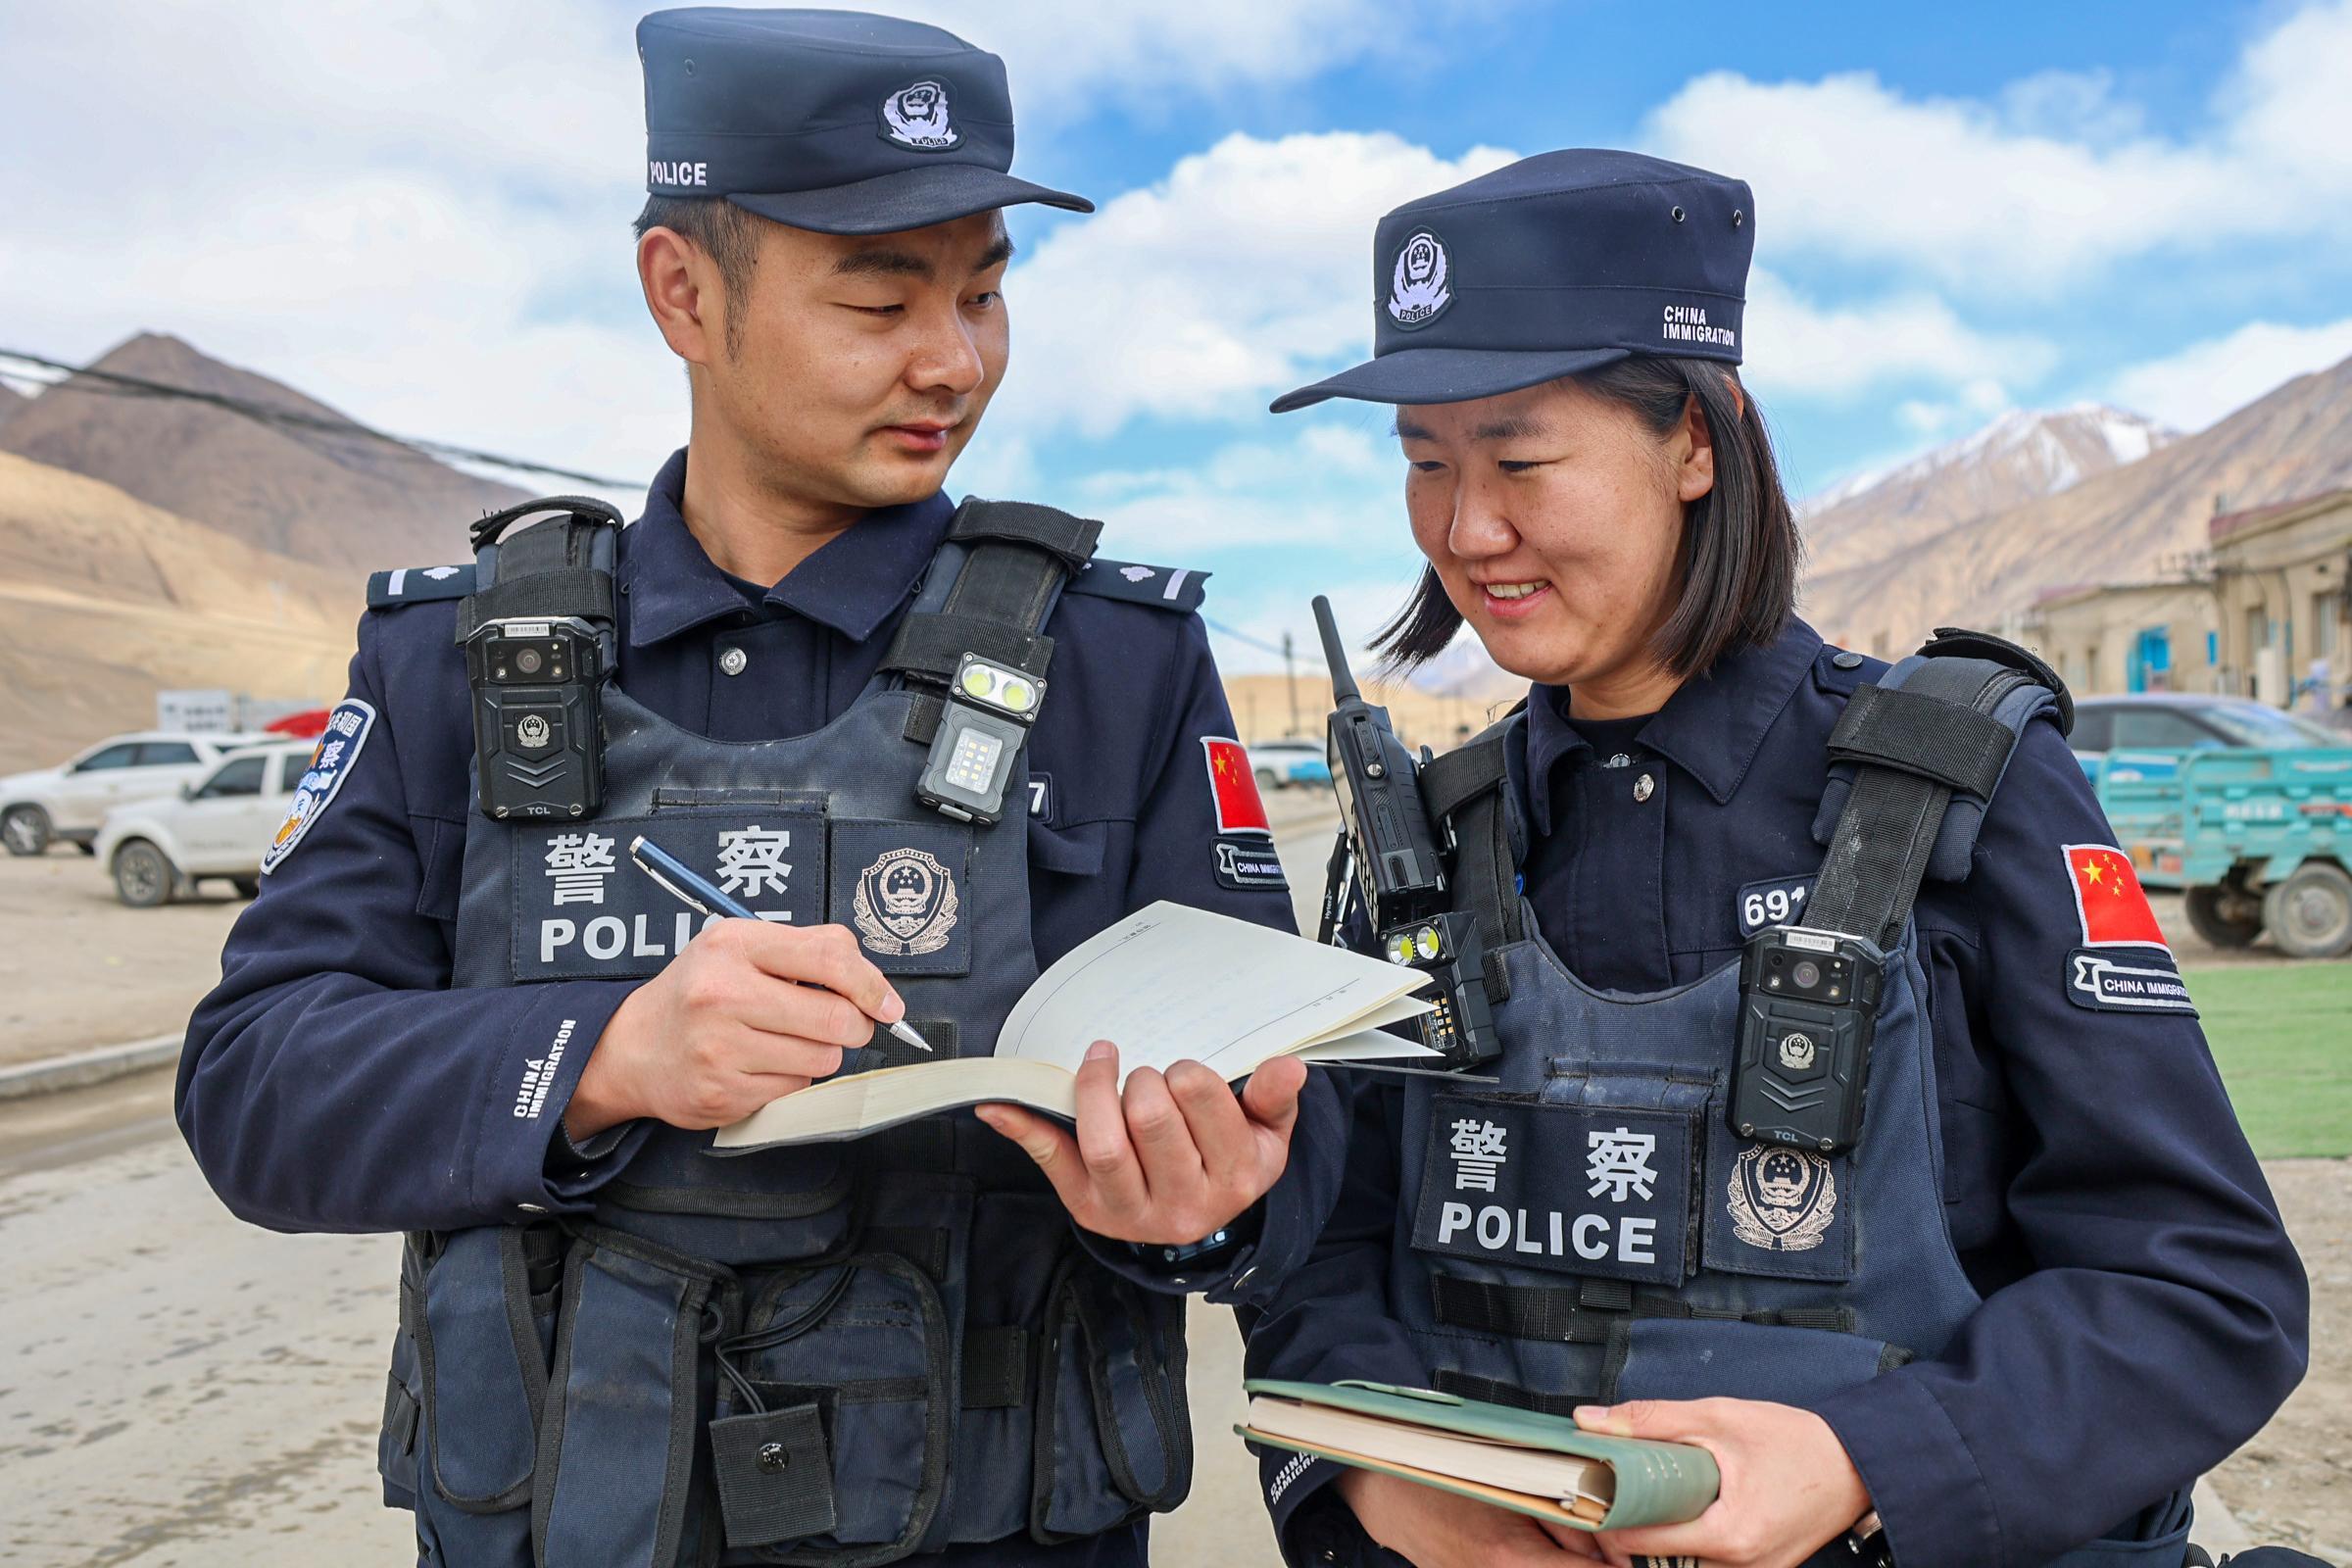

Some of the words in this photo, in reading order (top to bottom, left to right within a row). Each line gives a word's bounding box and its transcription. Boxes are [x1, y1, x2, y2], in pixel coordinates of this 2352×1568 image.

[650, 161, 708, 186] POLICE
[1399, 305, 1432, 320] POLICE
[1663, 305, 1707, 325] CHINA
[1663, 322, 1735, 347] IMMIGRATION
[1028, 782, 1046, 813] 7
[526, 807, 551, 815] TCL
[1237, 862, 1260, 874] CHINA
[541, 910, 792, 962] POLI
[2104, 979, 2145, 994] CHINA
[527, 1019, 577, 1118] IMMIGRATION
[514, 1058, 545, 1118] CHINA
[1774, 1130, 1798, 1143] TCL
[1438, 1200, 1657, 1264] POLICE
